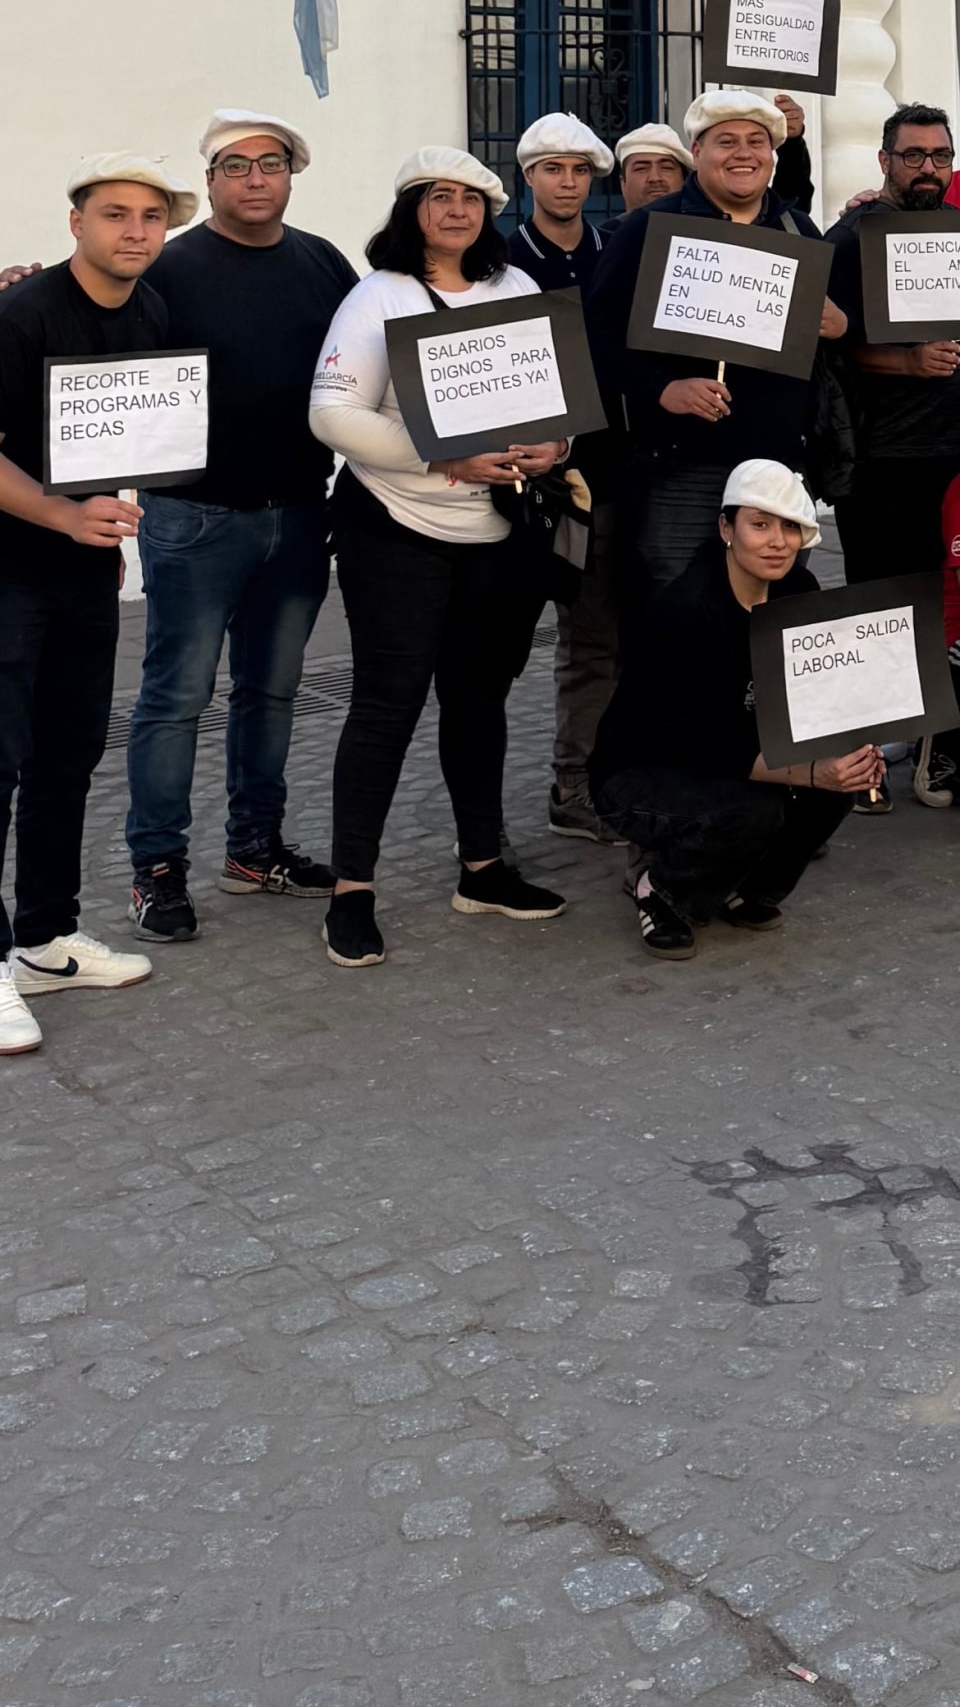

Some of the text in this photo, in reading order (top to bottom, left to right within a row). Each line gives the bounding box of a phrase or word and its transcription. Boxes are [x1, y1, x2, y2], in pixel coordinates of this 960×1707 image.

[735, 28, 776, 42] ENTRE
[736, 12, 815, 31] DESIGUALDAD
[734, 45, 809, 63] TERRITORIOS
[676, 246, 792, 279] FALTA DE
[894, 260, 912, 272] EL
[672, 265, 787, 298] SALUD MENTAL
[668, 284, 784, 317] EN LAS
[664, 303, 746, 328] ESCUELAS
[427, 334, 506, 361] SALARIOS
[430, 347, 552, 382] DIGNOS PARA
[60, 366, 201, 392] RECORTE DE
[434, 368, 550, 403] DOCENTES YA!
[60, 389, 201, 417] PROGRAMAS Y
[60, 420, 125, 441] BECAS
[791, 617, 910, 653] POCA SALIDA
[793, 649, 865, 677] LABORAL
